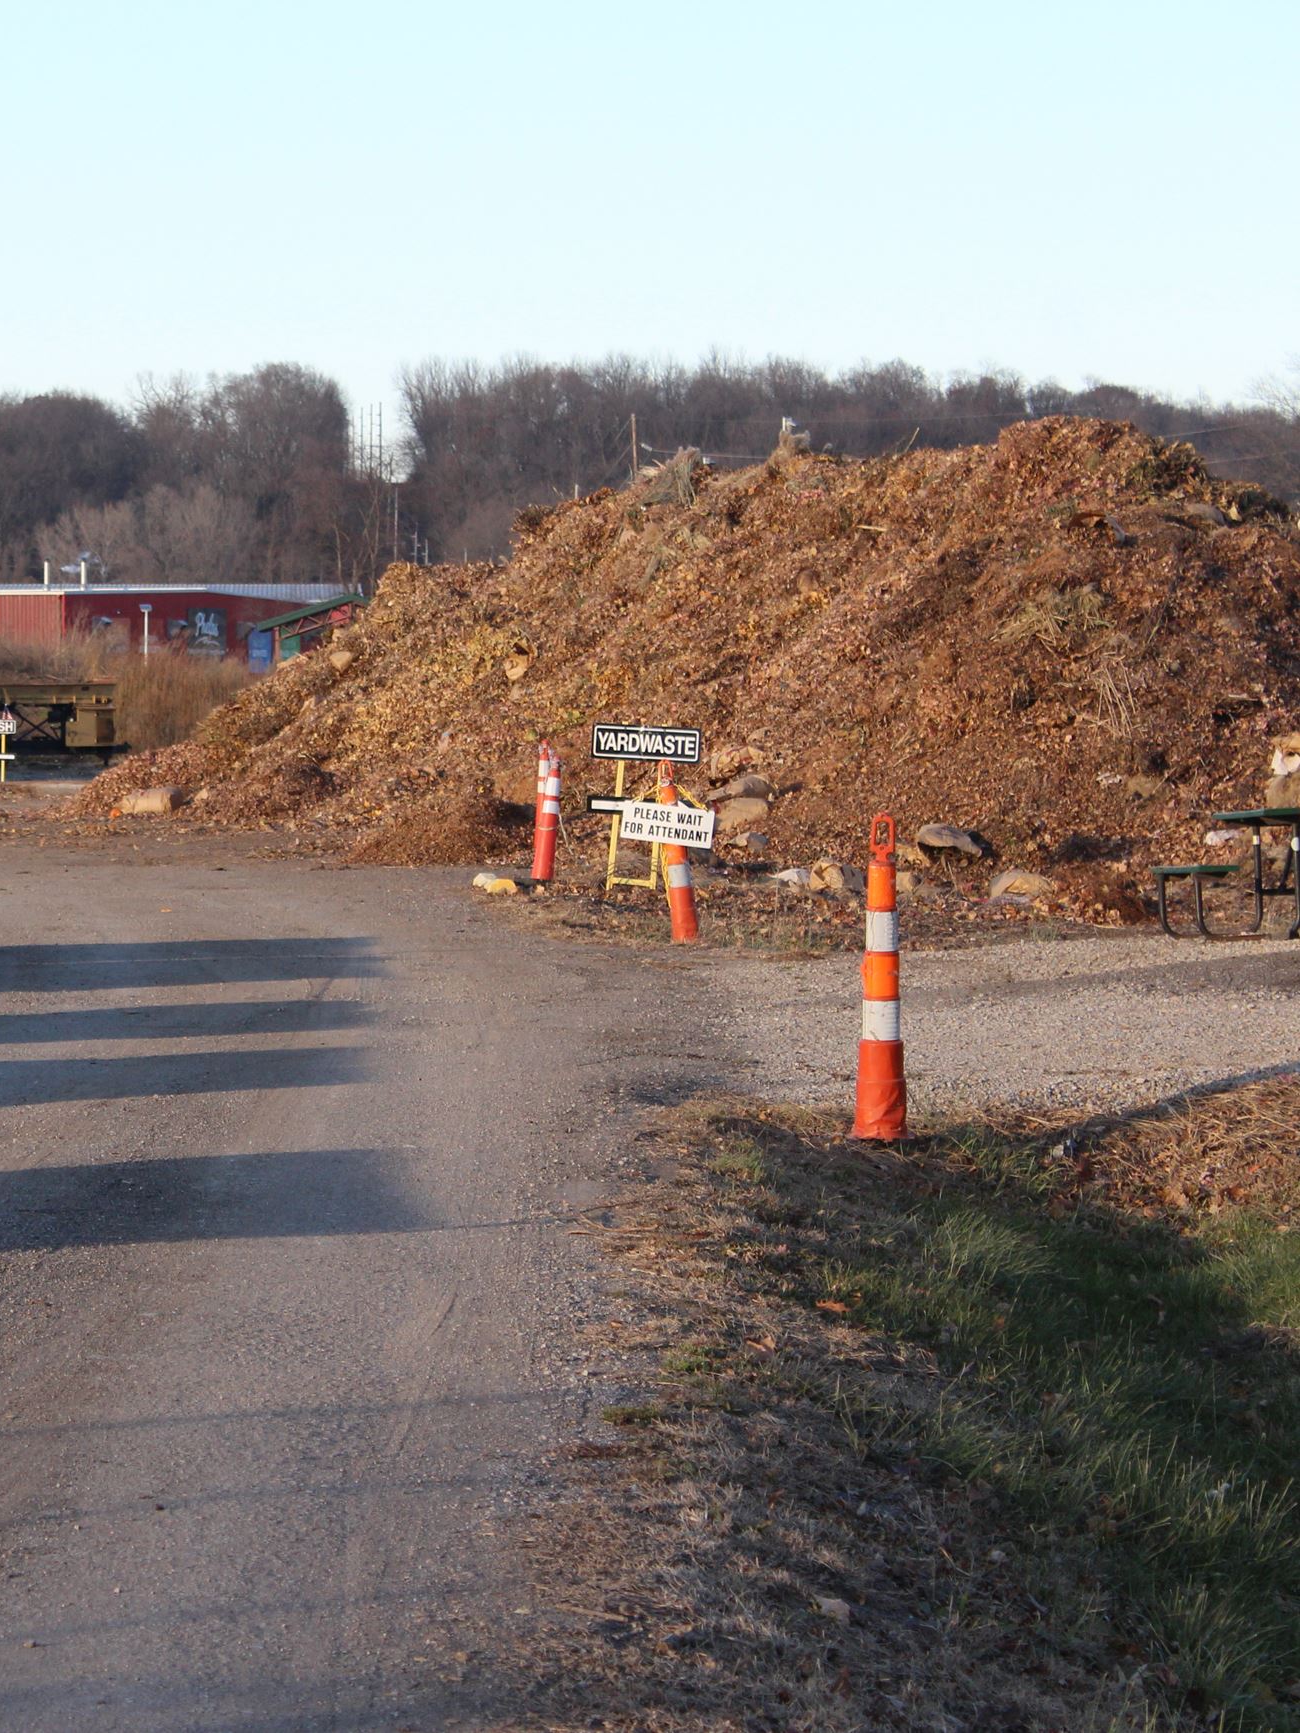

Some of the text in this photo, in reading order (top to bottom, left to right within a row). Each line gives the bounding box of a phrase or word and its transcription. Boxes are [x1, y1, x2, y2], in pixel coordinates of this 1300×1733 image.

[597, 731, 696, 756] YARDWASTE
[633, 807, 704, 827] PLEASE WAIT
[623, 821, 710, 843] FOR ATTENDANT
